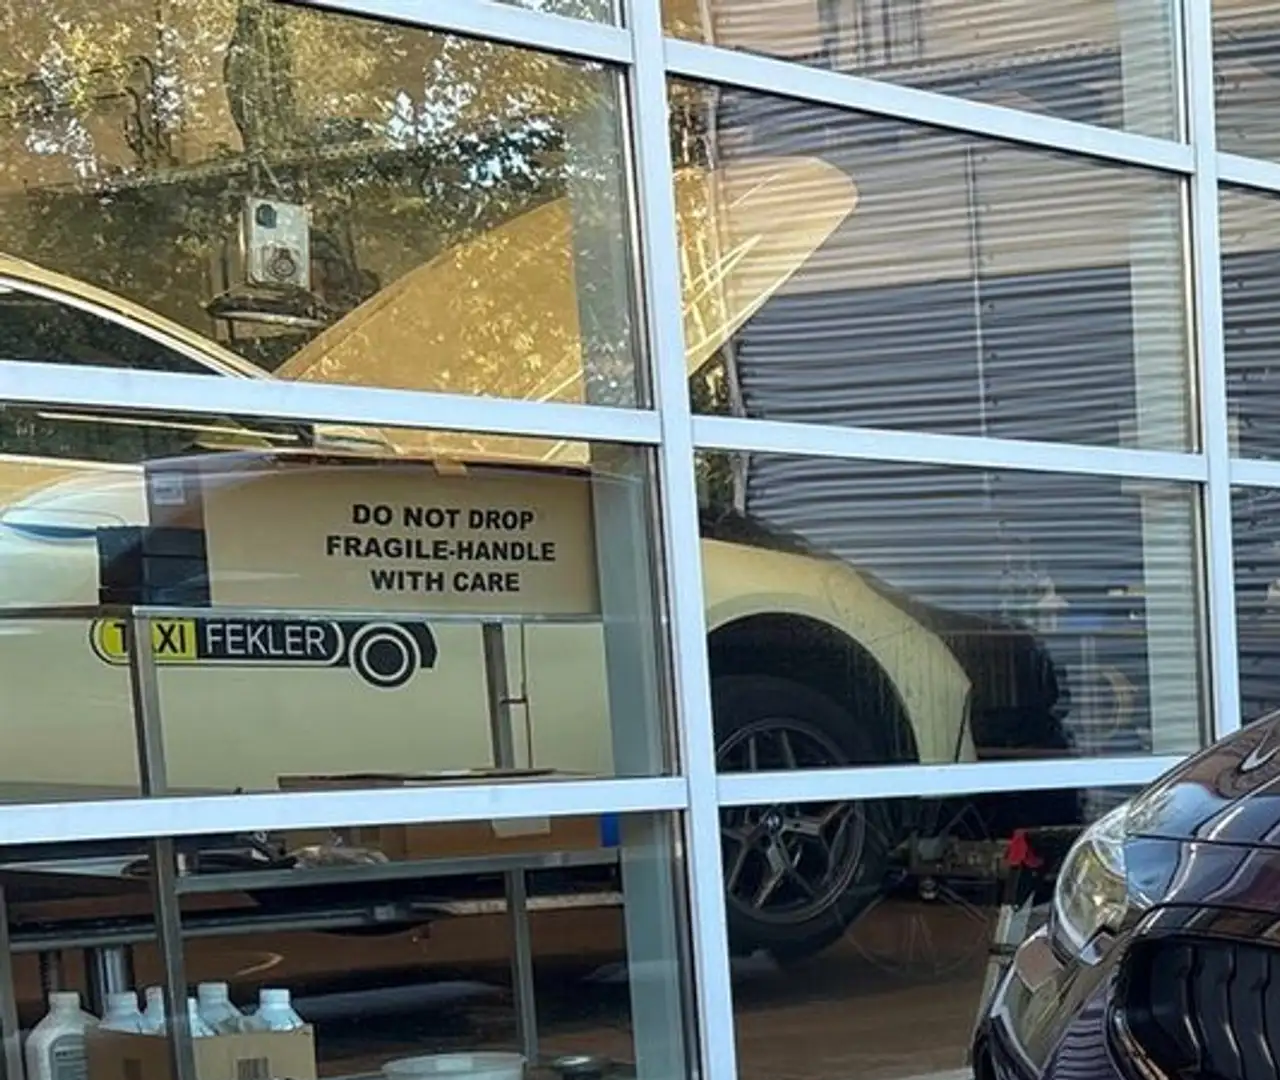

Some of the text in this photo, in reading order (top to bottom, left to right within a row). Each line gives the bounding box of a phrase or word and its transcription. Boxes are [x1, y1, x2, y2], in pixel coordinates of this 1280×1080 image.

[352, 504, 534, 530] DO NOT DROP
[326, 535, 556, 562] FRAGILE-HANDLE
[371, 570, 520, 592] WITH CARE
[113, 623, 328, 656] TXI FEKLER
